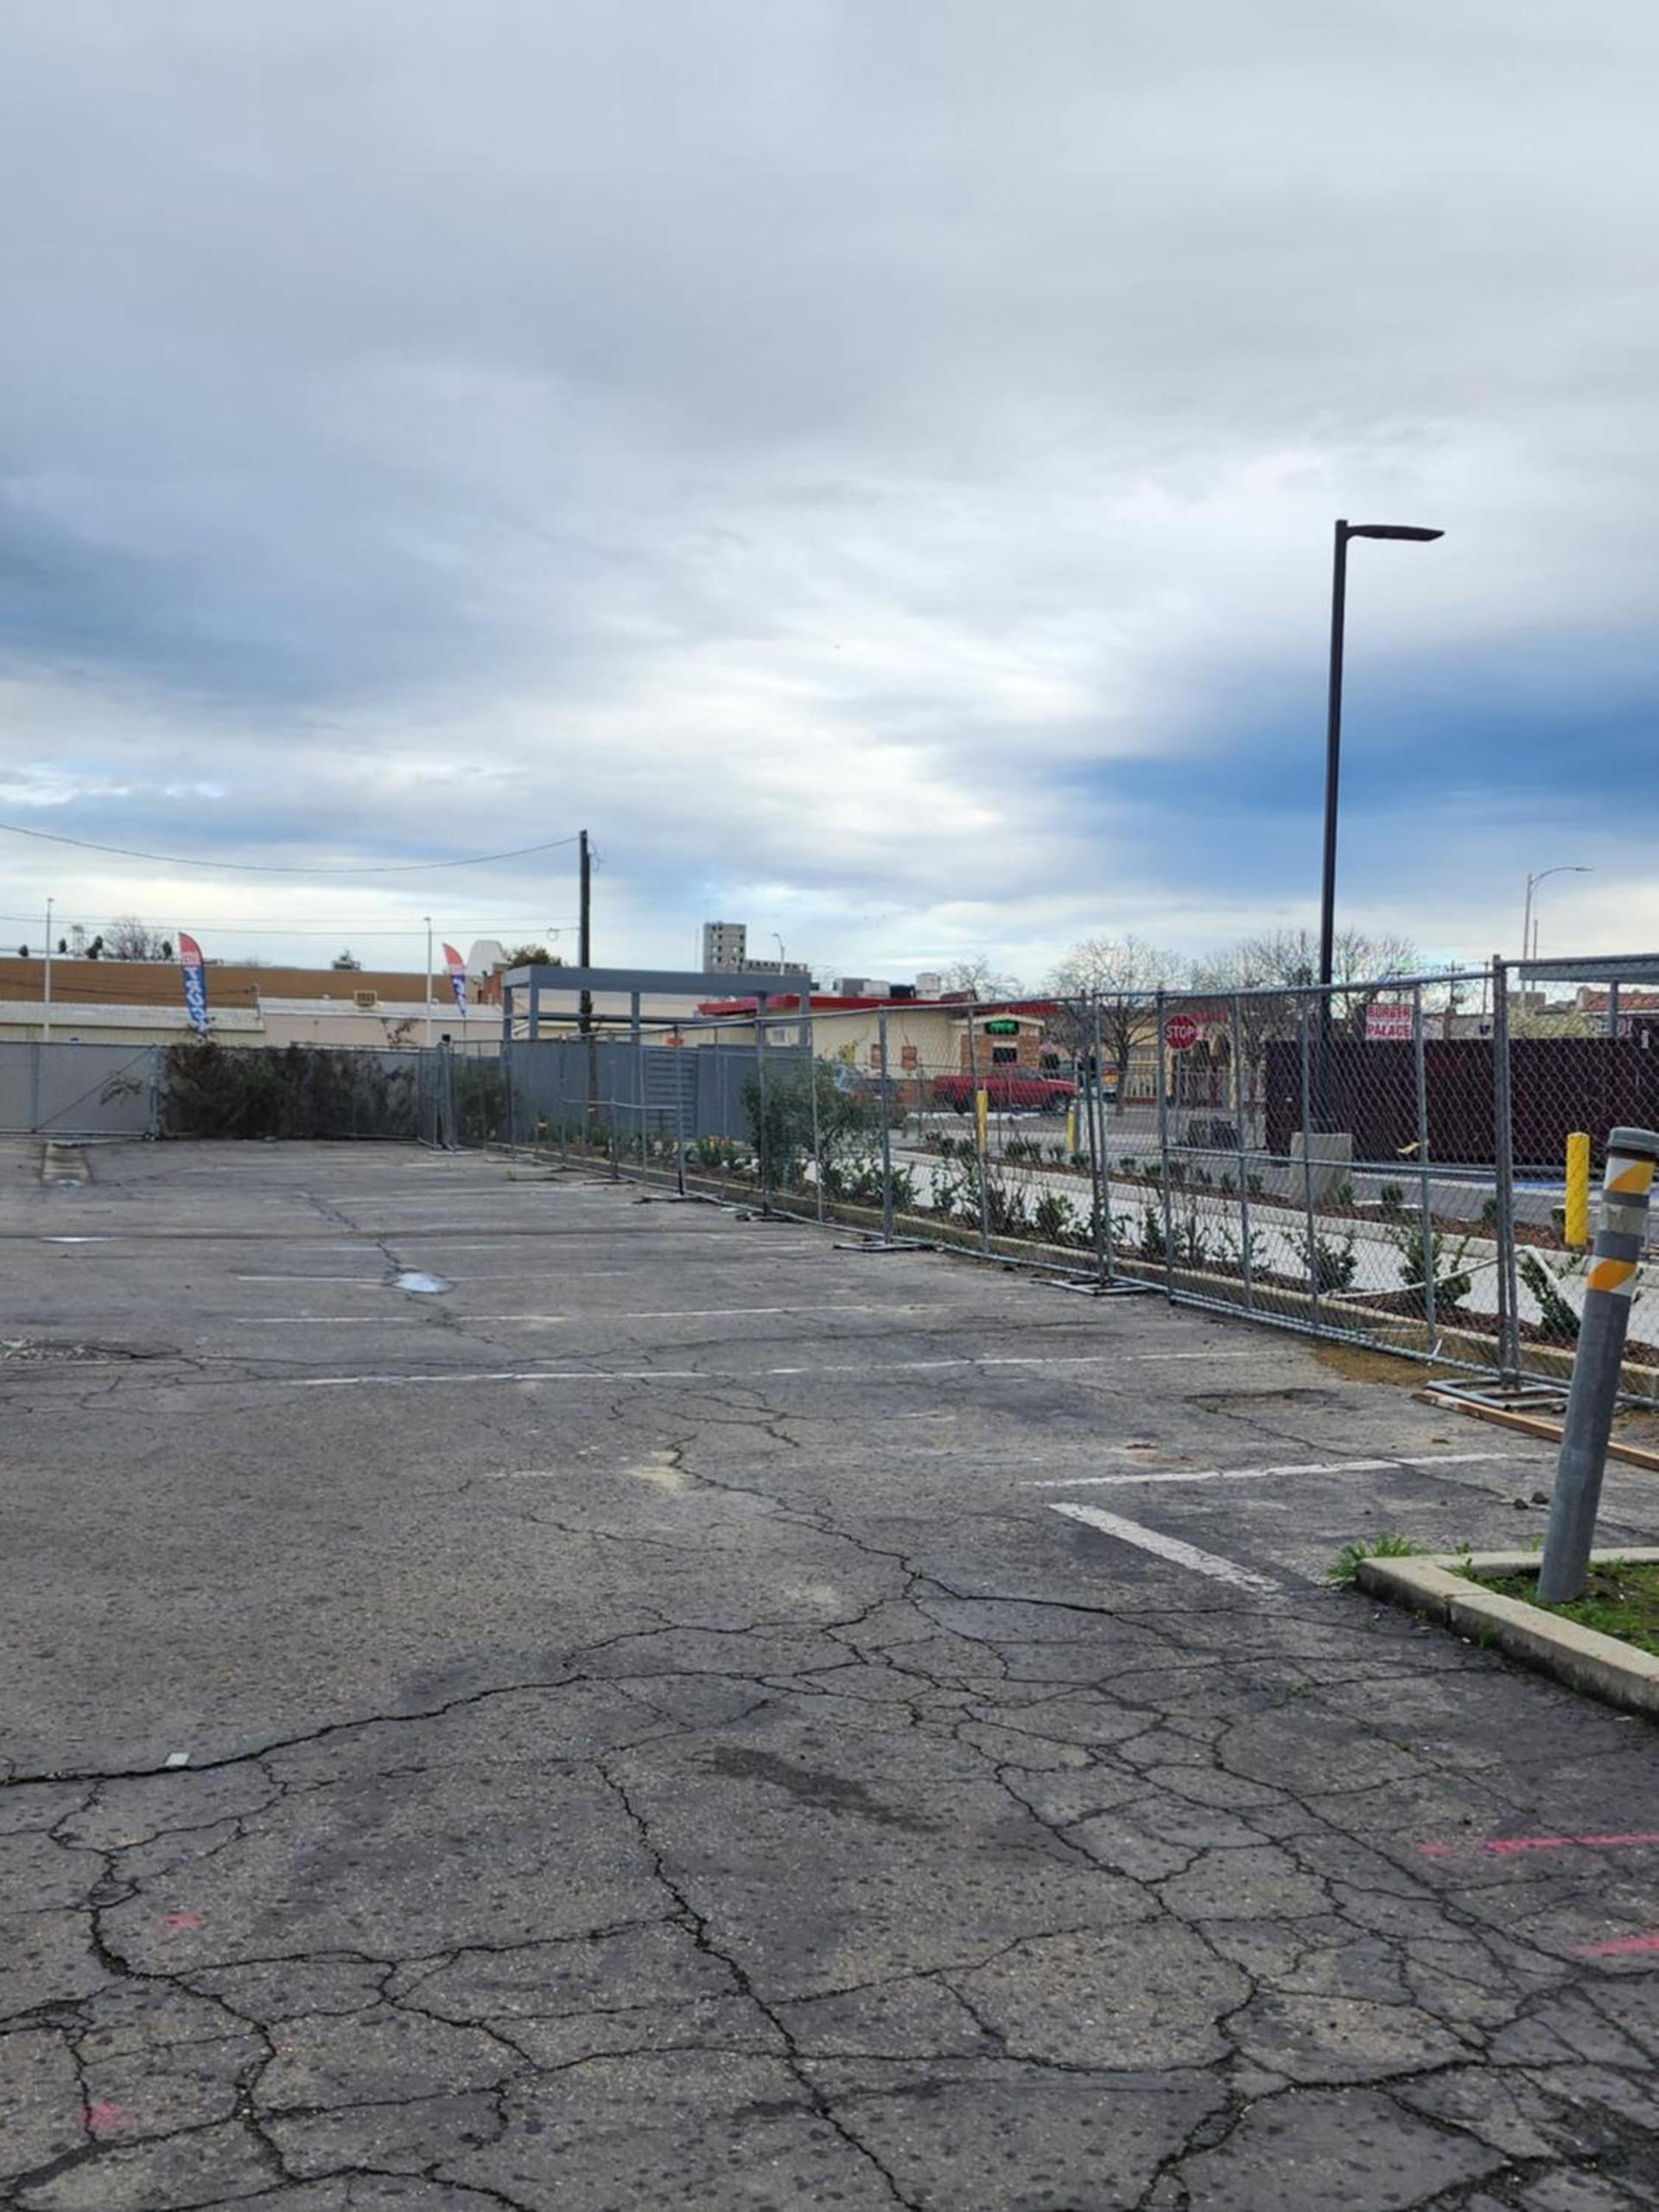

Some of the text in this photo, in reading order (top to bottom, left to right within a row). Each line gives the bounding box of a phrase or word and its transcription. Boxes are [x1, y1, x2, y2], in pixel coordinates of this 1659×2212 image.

[1367, 1007, 1411, 1019] BURGER
[1166, 1026, 1194, 1039] STOP
[1368, 1025, 1410, 1037] PALACE
